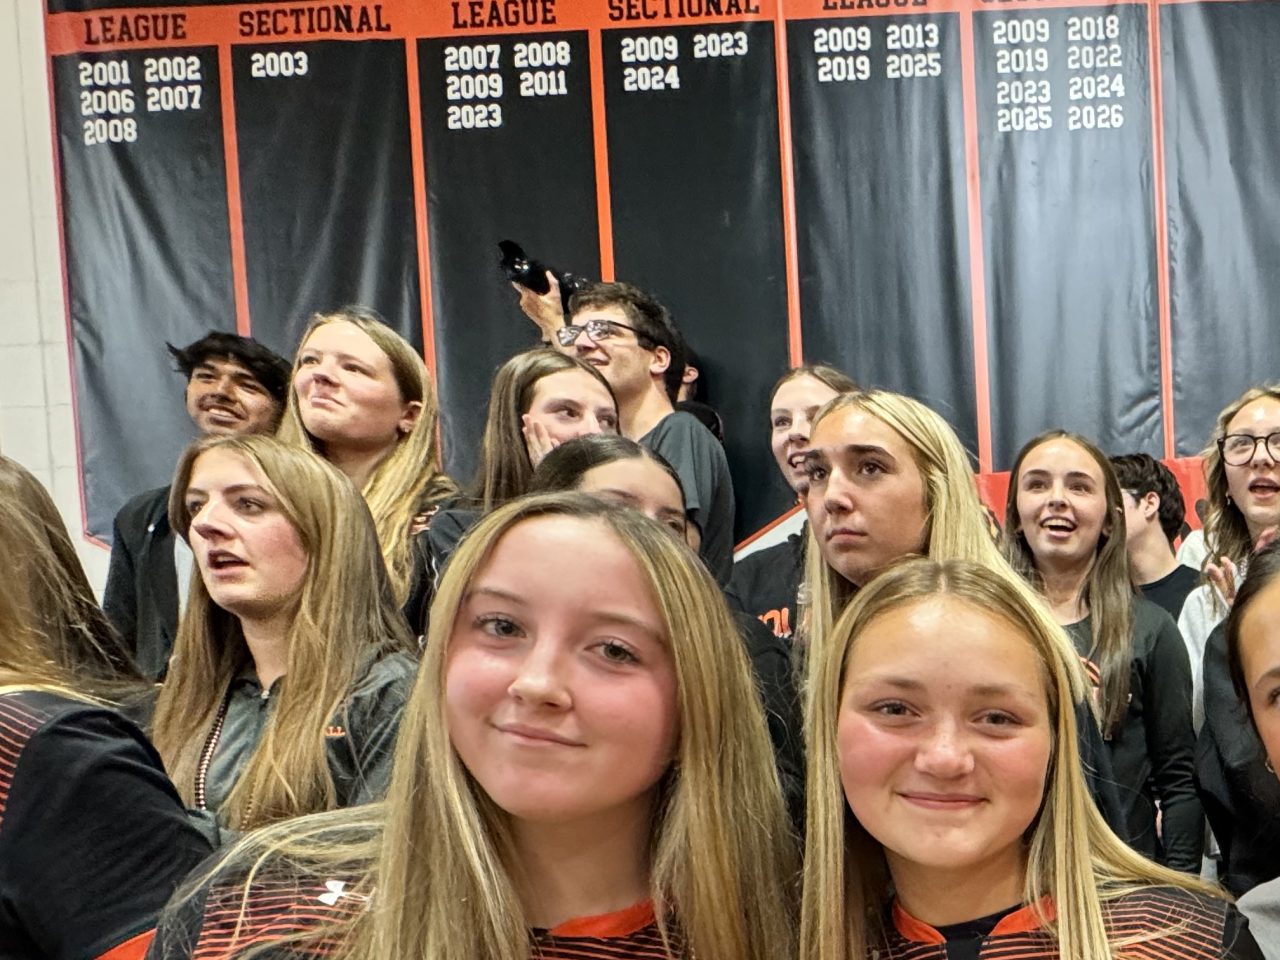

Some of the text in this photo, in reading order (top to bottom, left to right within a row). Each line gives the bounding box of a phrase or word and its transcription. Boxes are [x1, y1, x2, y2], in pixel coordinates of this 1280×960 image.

[238, 4, 391, 36] SECTIONAL
[452, 0, 557, 29] LEAGUE
[608, 0, 760, 21] SECTIONAL
[84, 14, 187, 45] LEAGUE
[814, 23, 939, 53] 2009 2013
[992, 15, 1119, 44] 2009 2018
[445, 41, 571, 71] 2007 2008
[621, 31, 748, 62] 2009 2023
[996, 44, 1122, 73] 2019 2022
[79, 56, 201, 86] 2001 2002
[251, 51, 308, 77] 2003
[623, 65, 680, 91] 2024
[818, 53, 941, 82] 2019 2025
[446, 70, 567, 100] 2009 2011
[997, 74, 1125, 105] 2023 2024
[80, 85, 202, 116] 2006 2007
[447, 104, 502, 129] 2023
[997, 104, 1124, 132] 2025 2026
[84, 118, 137, 146] 2008
